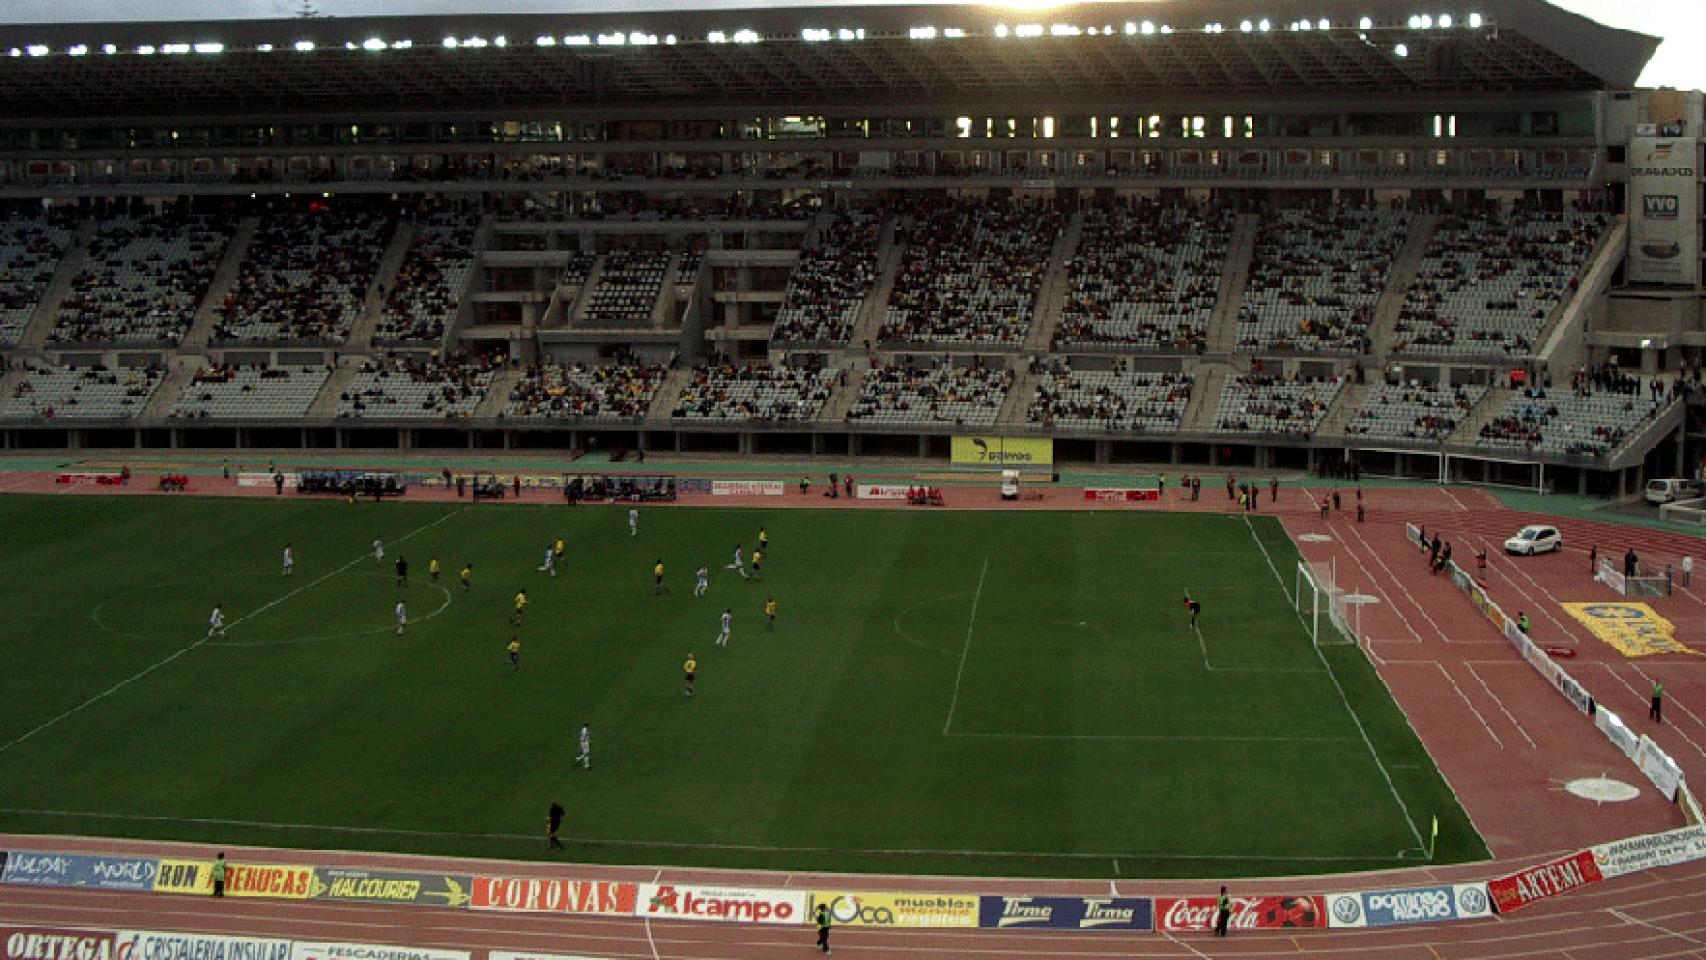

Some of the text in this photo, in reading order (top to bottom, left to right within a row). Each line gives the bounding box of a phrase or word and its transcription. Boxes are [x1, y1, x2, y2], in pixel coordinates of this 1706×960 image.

[94, 860, 155, 881] WORLD
[489, 879, 620, 911] CORONAS
[648, 885, 793, 921] Alcampo
[894, 897, 975, 906] muebles
[1002, 897, 1053, 916] Tirma
[1083, 899, 1135, 918] Tirma
[7, 933, 112, 960] ORTEGA
